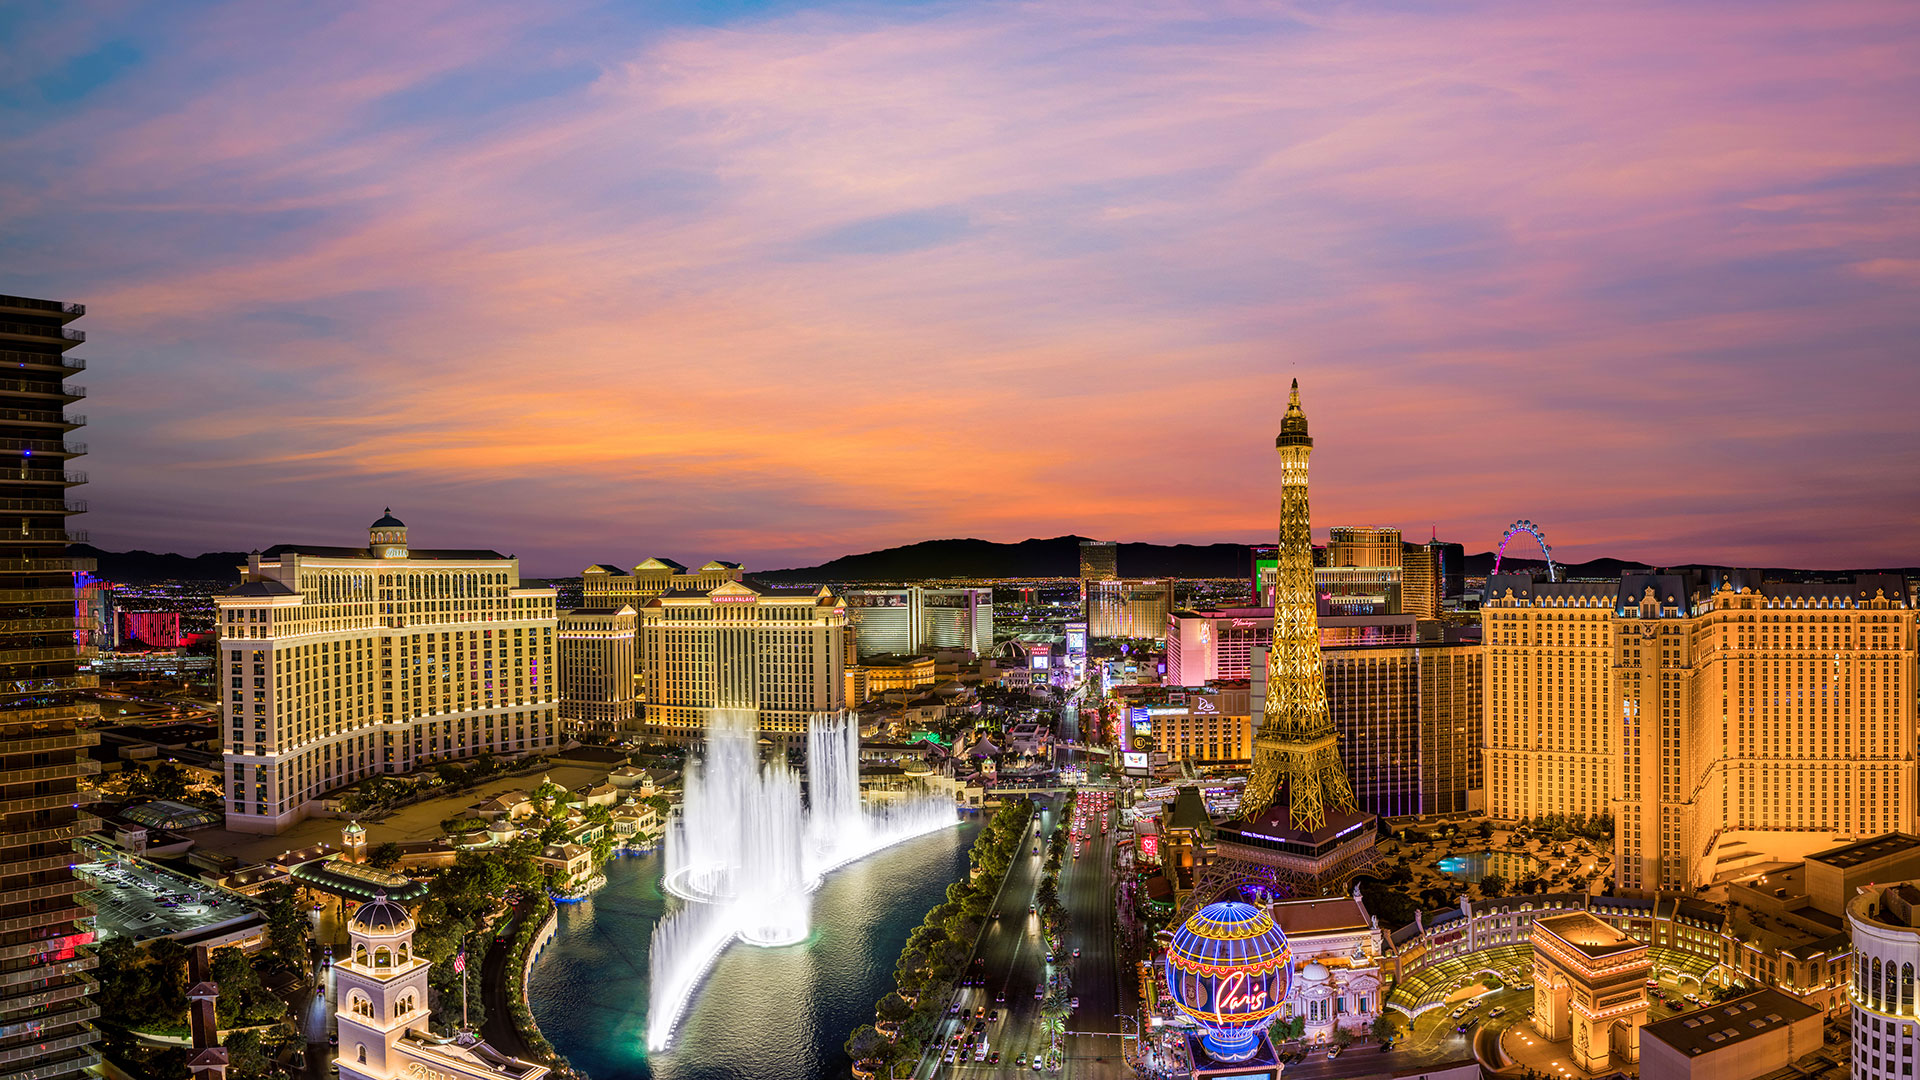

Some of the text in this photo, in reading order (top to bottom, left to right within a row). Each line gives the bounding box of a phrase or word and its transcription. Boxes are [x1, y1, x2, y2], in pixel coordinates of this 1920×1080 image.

[932, 596, 947, 605] LOVE
[1232, 618, 1257, 627] Flamingo
[1216, 970, 1268, 1026] Paris
